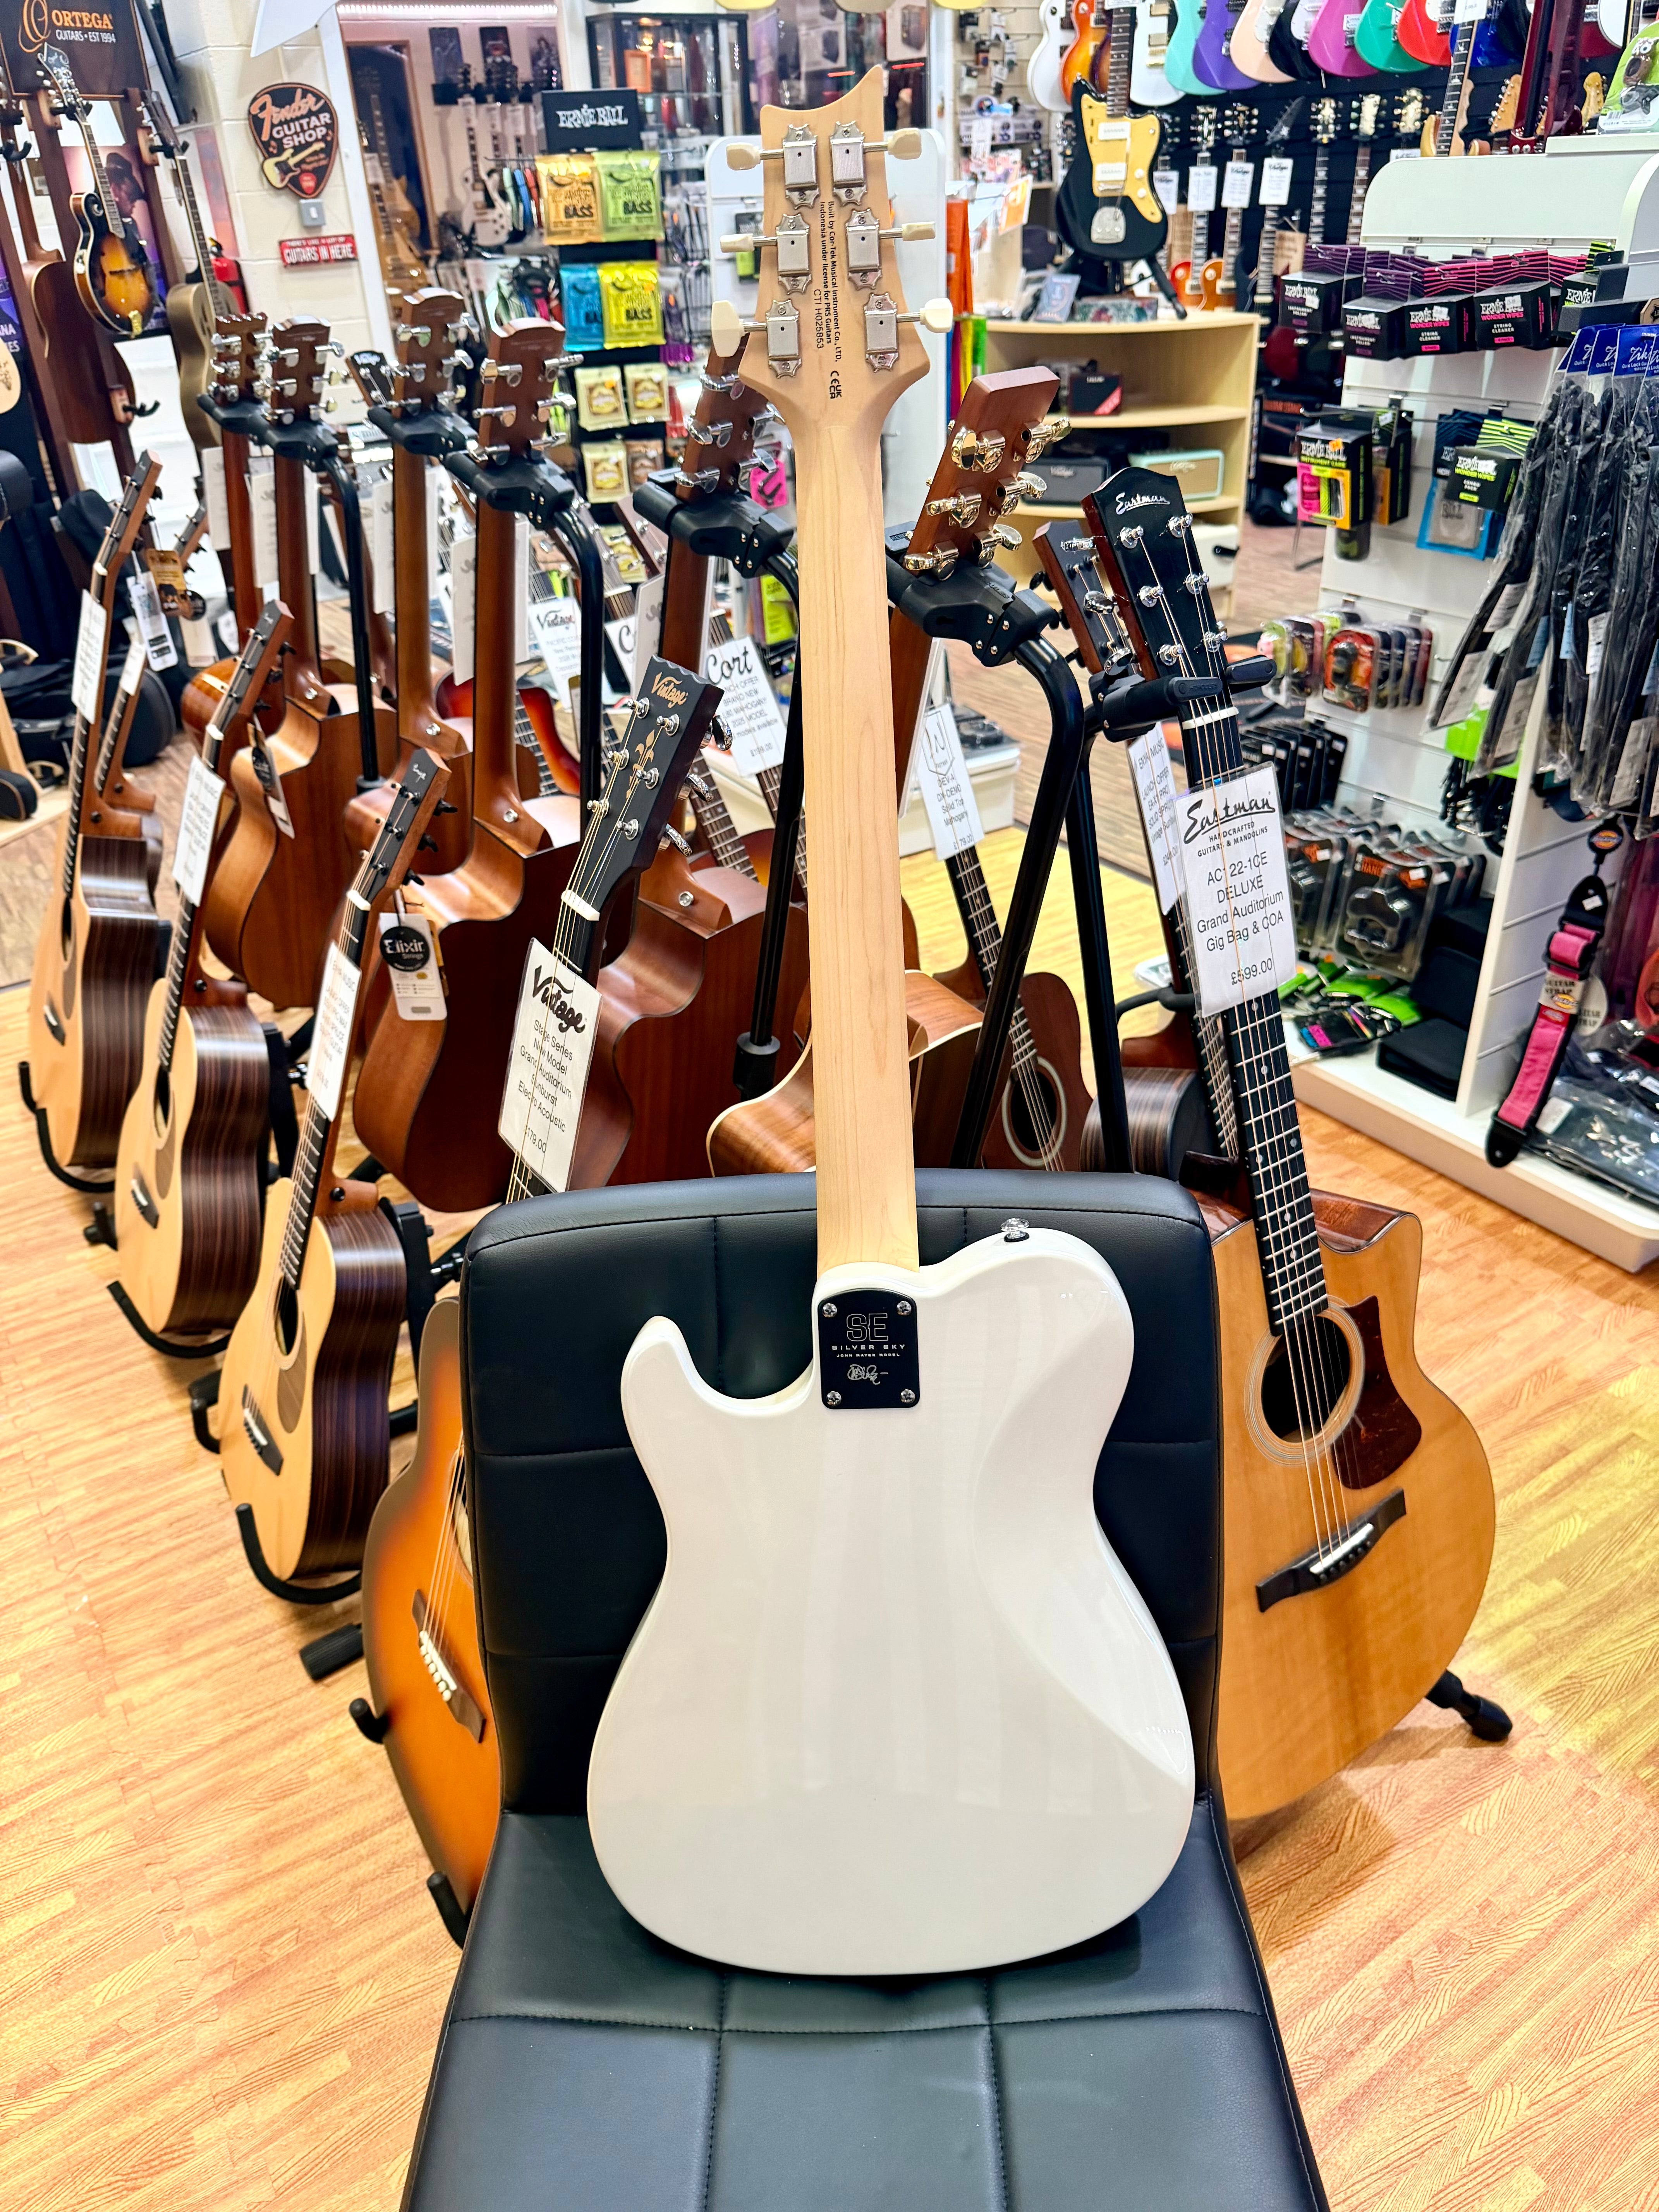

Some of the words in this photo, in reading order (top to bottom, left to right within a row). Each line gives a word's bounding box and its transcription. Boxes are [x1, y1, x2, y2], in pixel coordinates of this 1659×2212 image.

[52, 10, 113, 29] ORTEGA
[55, 29, 84, 41] GUITARS
[89, 32, 100, 42] EST
[100, 33, 116, 43] 1994
[250, 88, 325, 142] Fender
[272, 113, 331, 138] GUITAR
[556, 104, 596, 128] ERNIE
[596, 105, 628, 127] BALL
[282, 127, 327, 148] SHOP
[828, 220, 835, 229] by
[831, 261, 839, 288] Musical
[1480, 298, 1504, 315] ERNIE
[1565, 288, 1592, 304] ERNIE
[1409, 307, 1432, 323] ERNIE
[1480, 313, 1506, 321] WONDER
[1115, 492, 1170, 515] Eastman
[707, 646, 752, 685] Cort
[651, 672, 688, 709] Vintage
[1149, 738, 1164, 759] MUSIC
[1156, 766, 1170, 785] OFFER
[1183, 798, 1276, 845] Eastman
[1209, 821, 1255, 843] HANDCRAFTED
[953, 834, 973, 850] £79.00
[1197, 842, 1224, 857] GUITARS
[1233, 826, 1268, 844] MANDOLINS
[1207, 851, 1267, 886] AC22-1CE
[1217, 874, 1264, 903] DELUXE
[1197, 910, 1229, 933] Grand
[1233, 891, 1284, 920] Auditorium
[1207, 936, 1224, 952] Gig
[1226, 927, 1249, 944] Bag
[1252, 921, 1260, 934] &
[1262, 910, 1284, 929] COA
[383, 939, 424, 954] Elixir
[1231, 958, 1273, 986] £599.00
[532, 965, 586, 1034] Vintage
[534, 1038, 546, 1057] Nw
[546, 1051, 567, 1075] Model
[551, 1036, 573, 1060] Series
[539, 1063, 572, 1099] Auditorium
[519, 1080, 537, 1107] Elecro
[538, 1102, 566, 1132] Acoustic
[847, 1313, 888, 1341] SE
